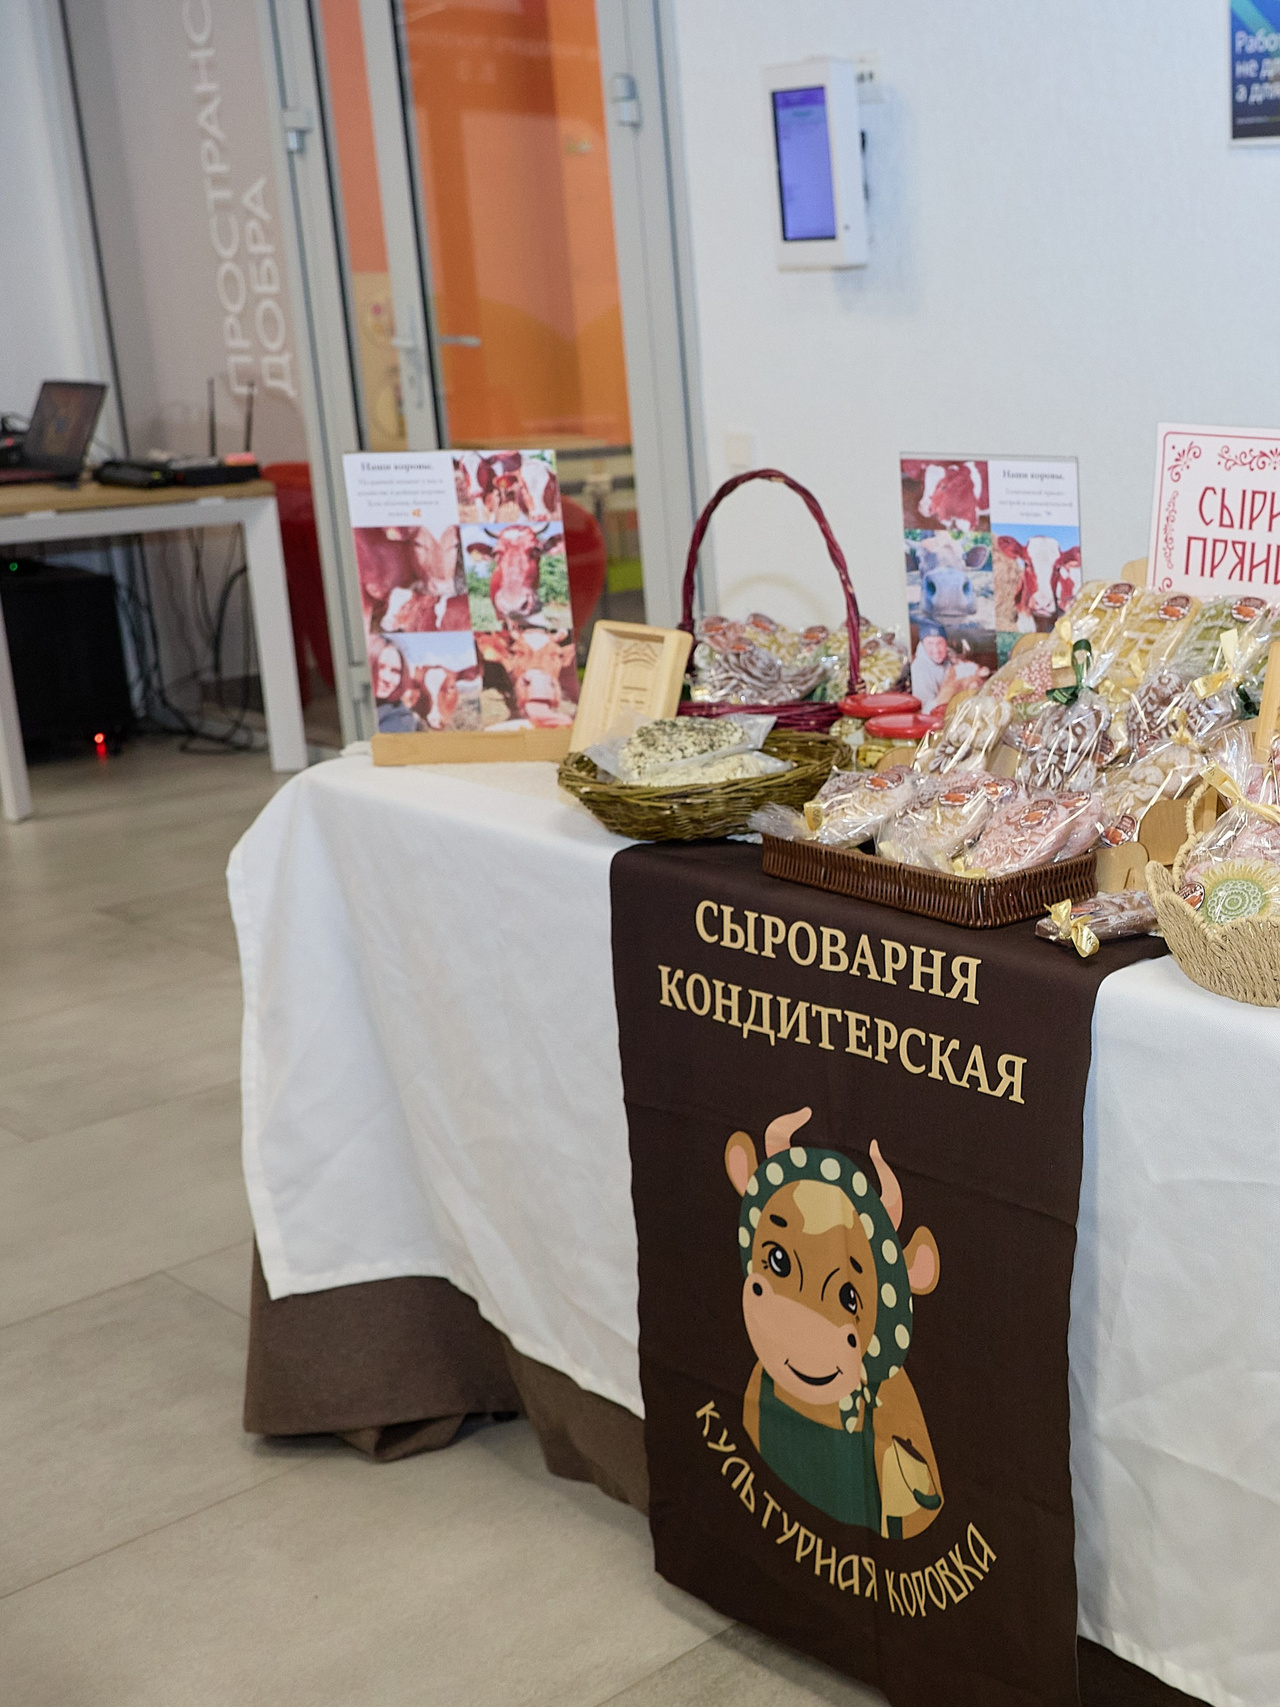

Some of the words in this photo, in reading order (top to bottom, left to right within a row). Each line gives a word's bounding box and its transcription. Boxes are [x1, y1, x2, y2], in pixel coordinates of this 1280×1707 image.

[1235, 59, 1259, 79] не
[1235, 84, 1247, 103] а
[242, 177, 297, 398] ДОБРА
[695, 900, 982, 1005] СЫРОВАРНЯ
[657, 964, 1028, 1105] КОНДИТЕРСКАЯ
[696, 1400, 878, 1602] КУЛЬТУРНАЯ
[885, 1521, 998, 1618] КОРОВКА
